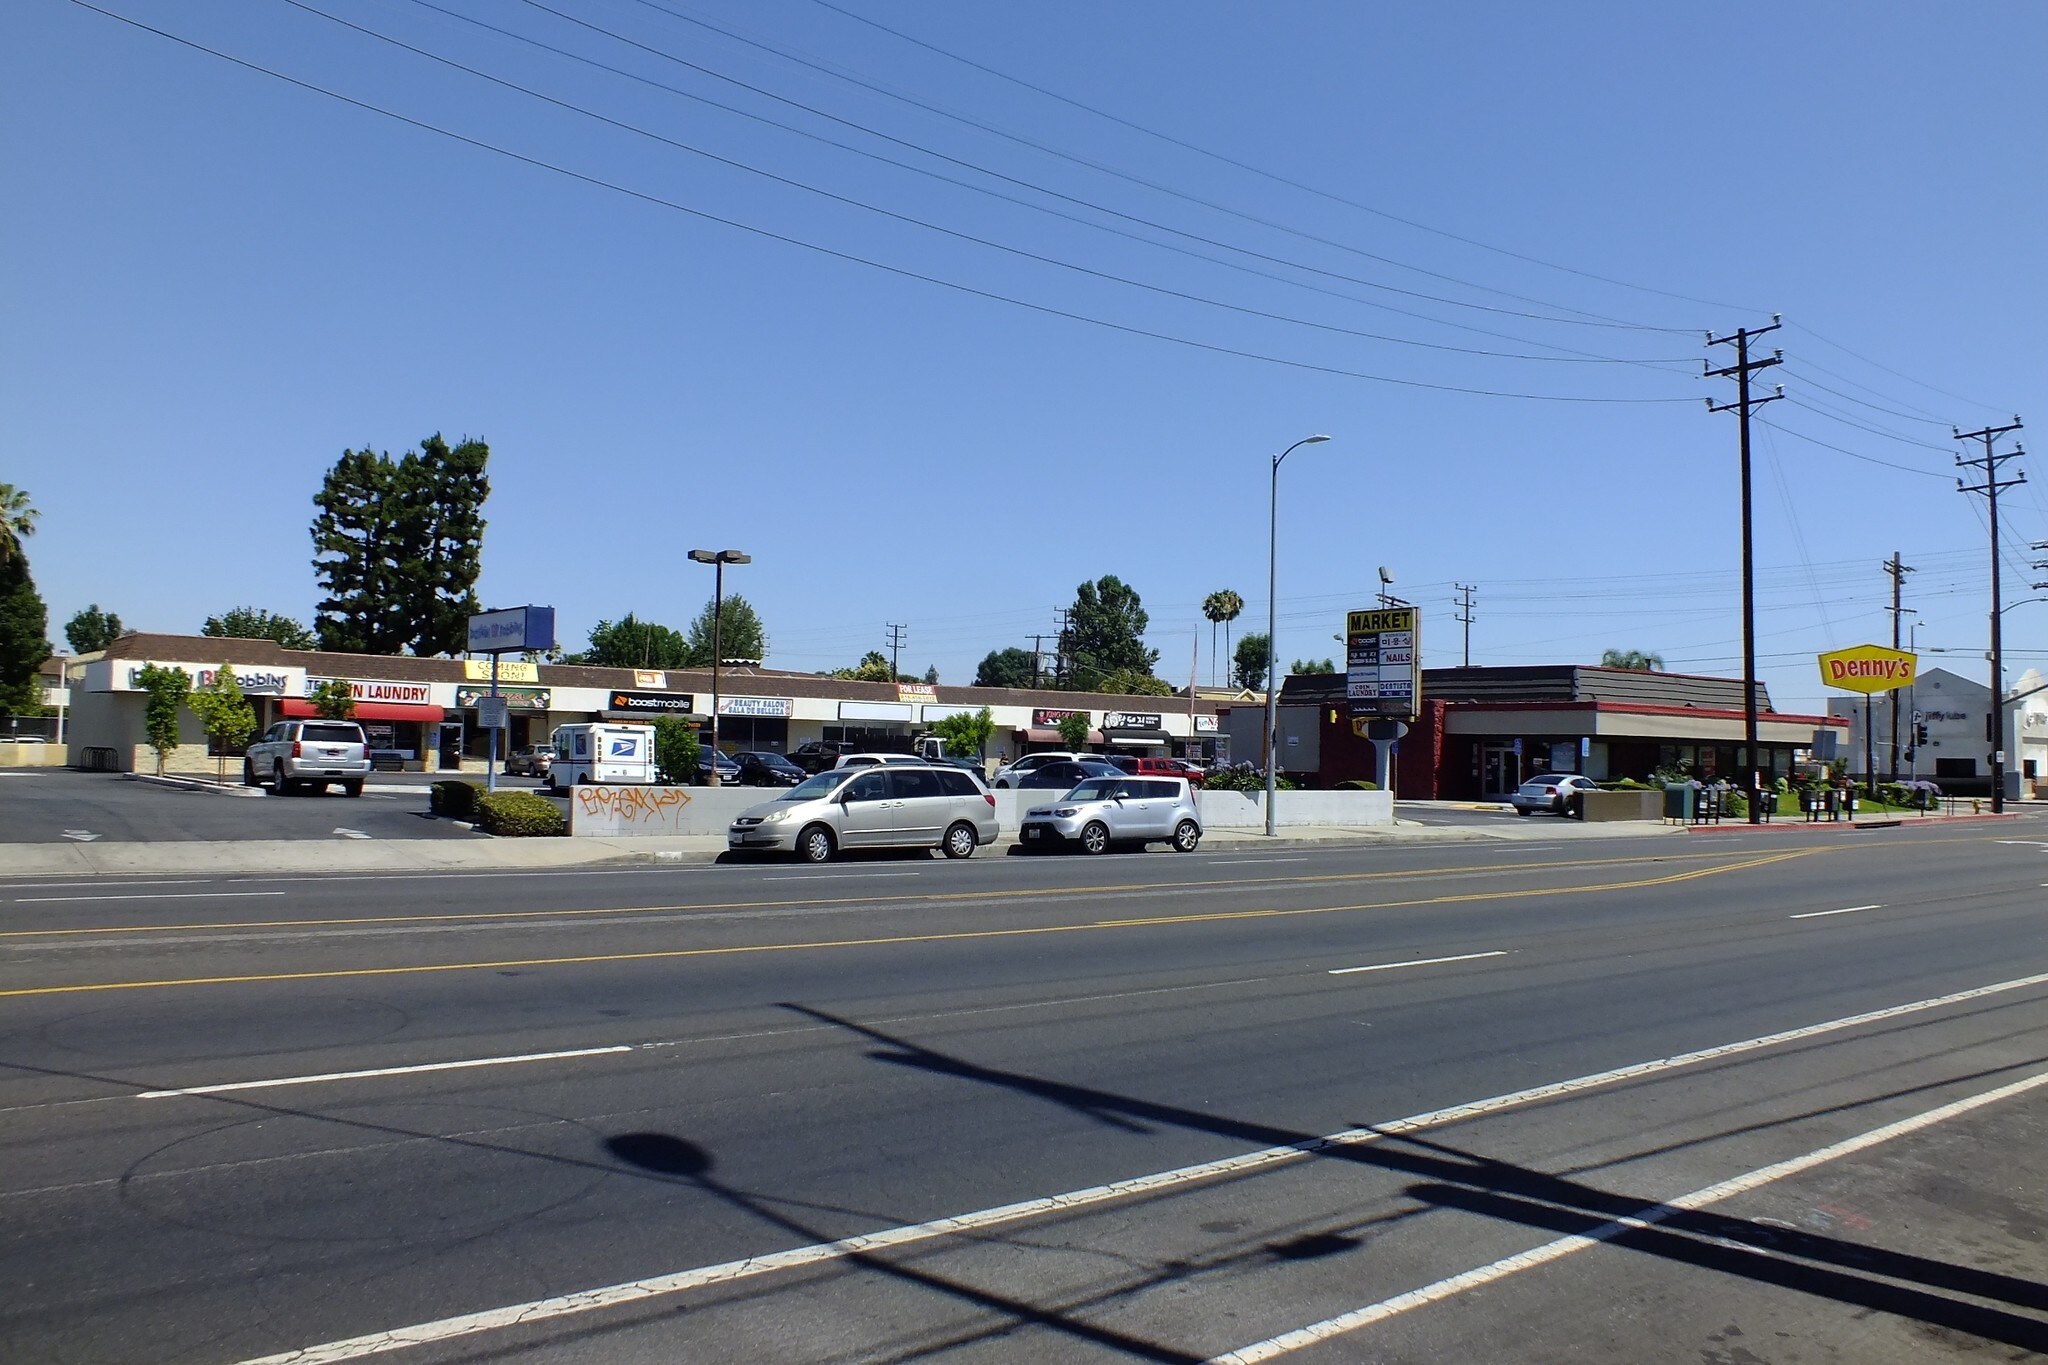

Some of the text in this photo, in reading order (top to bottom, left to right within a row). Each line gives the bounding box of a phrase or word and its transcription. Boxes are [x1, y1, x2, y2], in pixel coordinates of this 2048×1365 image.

[1350, 612, 1410, 631] MARKET
[1386, 653, 1411, 662] NAILS
[1829, 658, 1910, 680] Denny's
[481, 670, 525, 680] SON!
[368, 684, 427, 701] LAUNDRY
[899, 684, 933, 694] FOR LEASE
[1348, 689, 1378, 697] LAUNDRY
[734, 699, 762, 707] BEAUTY
[763, 700, 785, 708] SALON
[728, 706, 745, 714] SALA
[756, 707, 784, 715] BELLEZA
